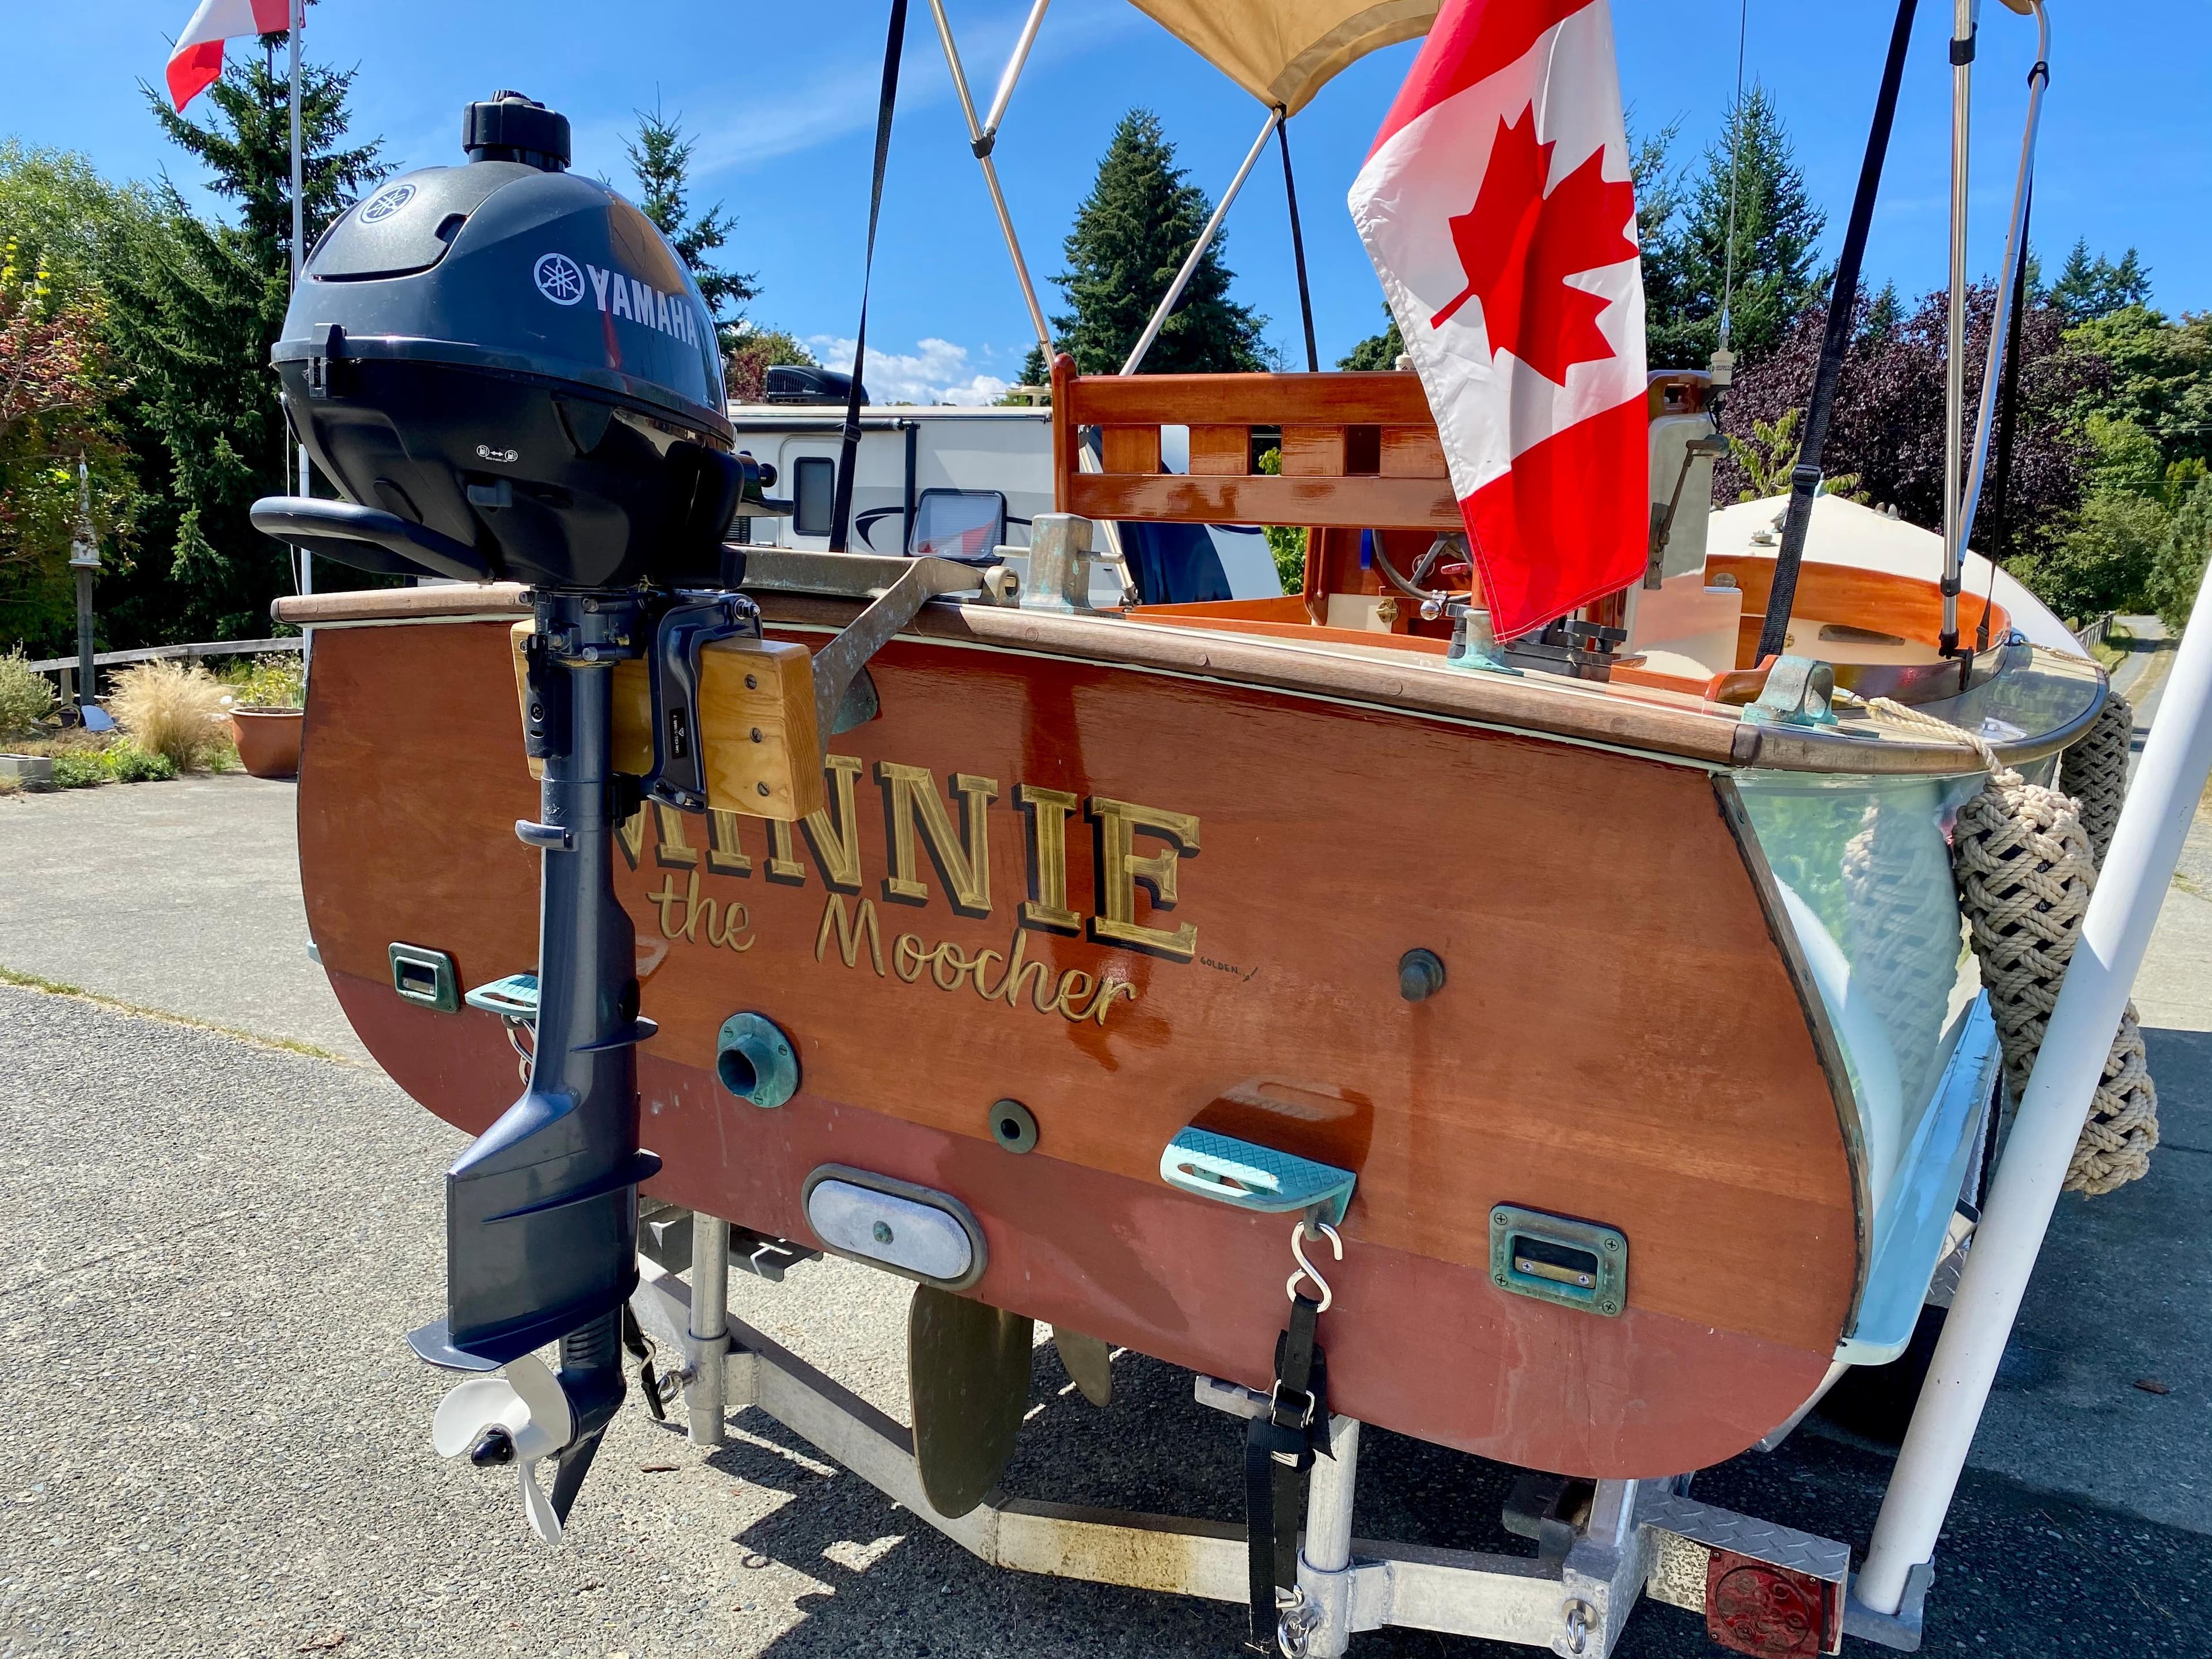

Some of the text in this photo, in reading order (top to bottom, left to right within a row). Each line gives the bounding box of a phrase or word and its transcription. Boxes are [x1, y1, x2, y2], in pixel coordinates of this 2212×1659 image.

[586, 264, 699, 350] YAMAHA
[646, 870, 1137, 1027] the Moocher
